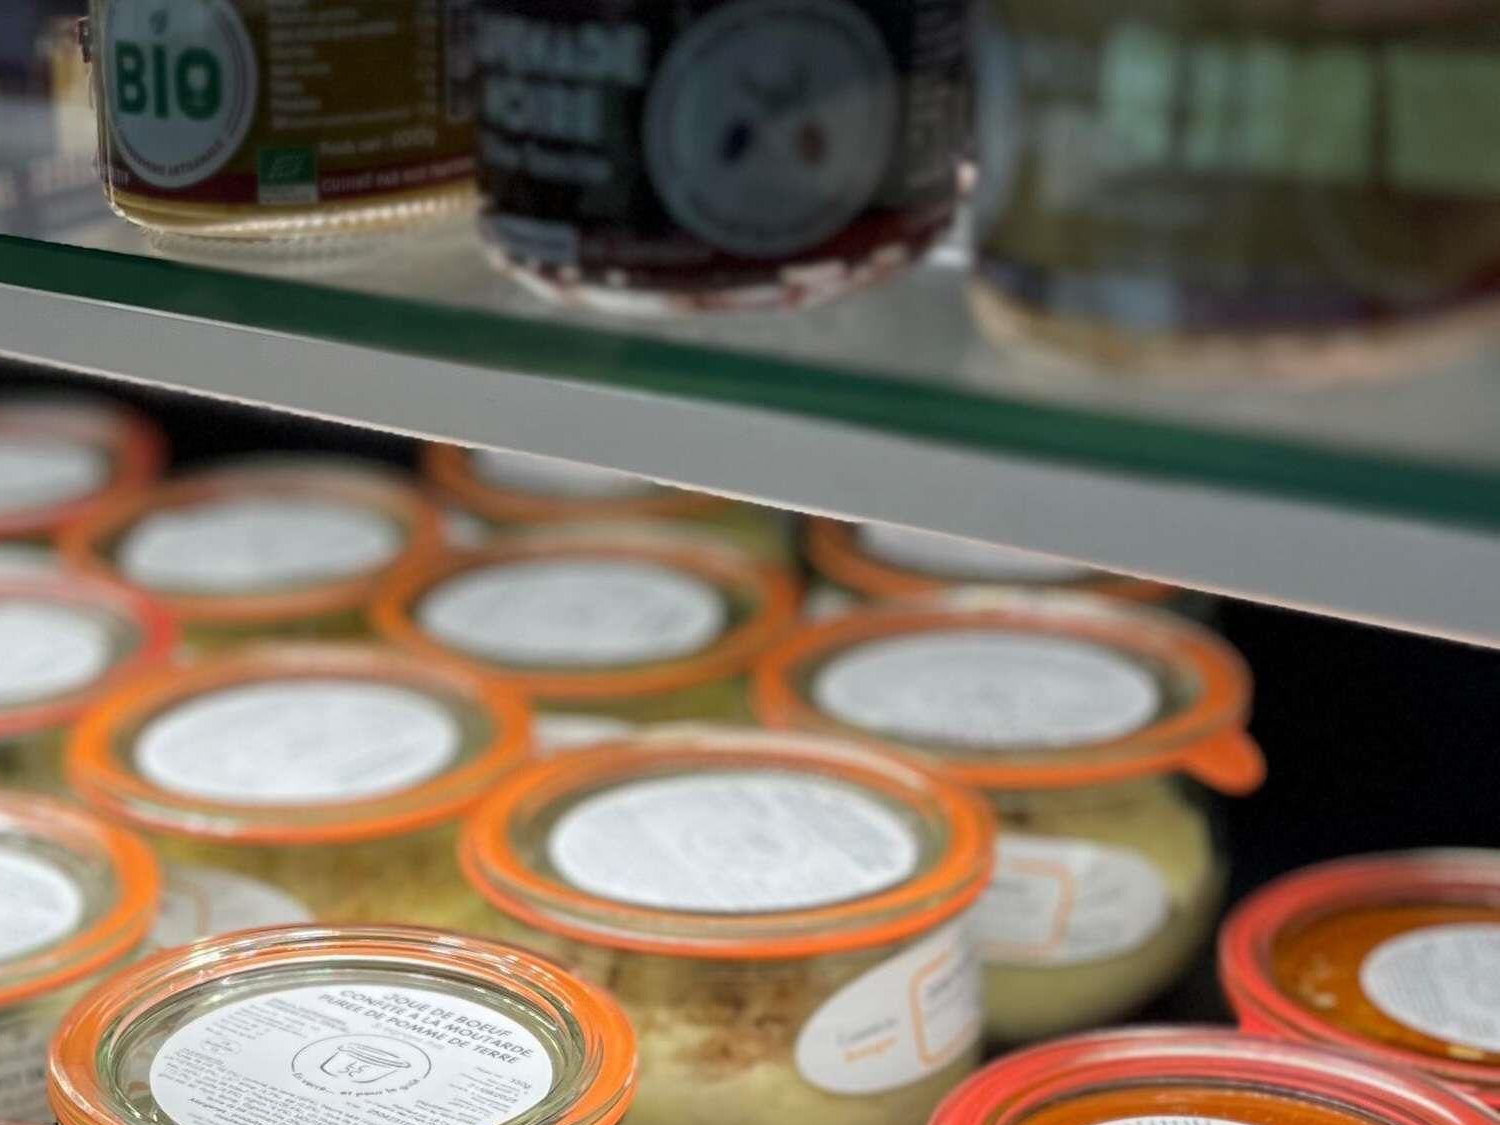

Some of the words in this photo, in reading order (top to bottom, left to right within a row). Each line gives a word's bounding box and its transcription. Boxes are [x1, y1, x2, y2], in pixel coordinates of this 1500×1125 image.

[115, 38, 223, 122] BIO
[362, 1008, 386, 1021] DE
[385, 1016, 448, 1041] POMME
[446, 1036, 470, 1048] DE
[472, 1044, 519, 1064] TERRE
[428, 1007, 455, 1020] DE
